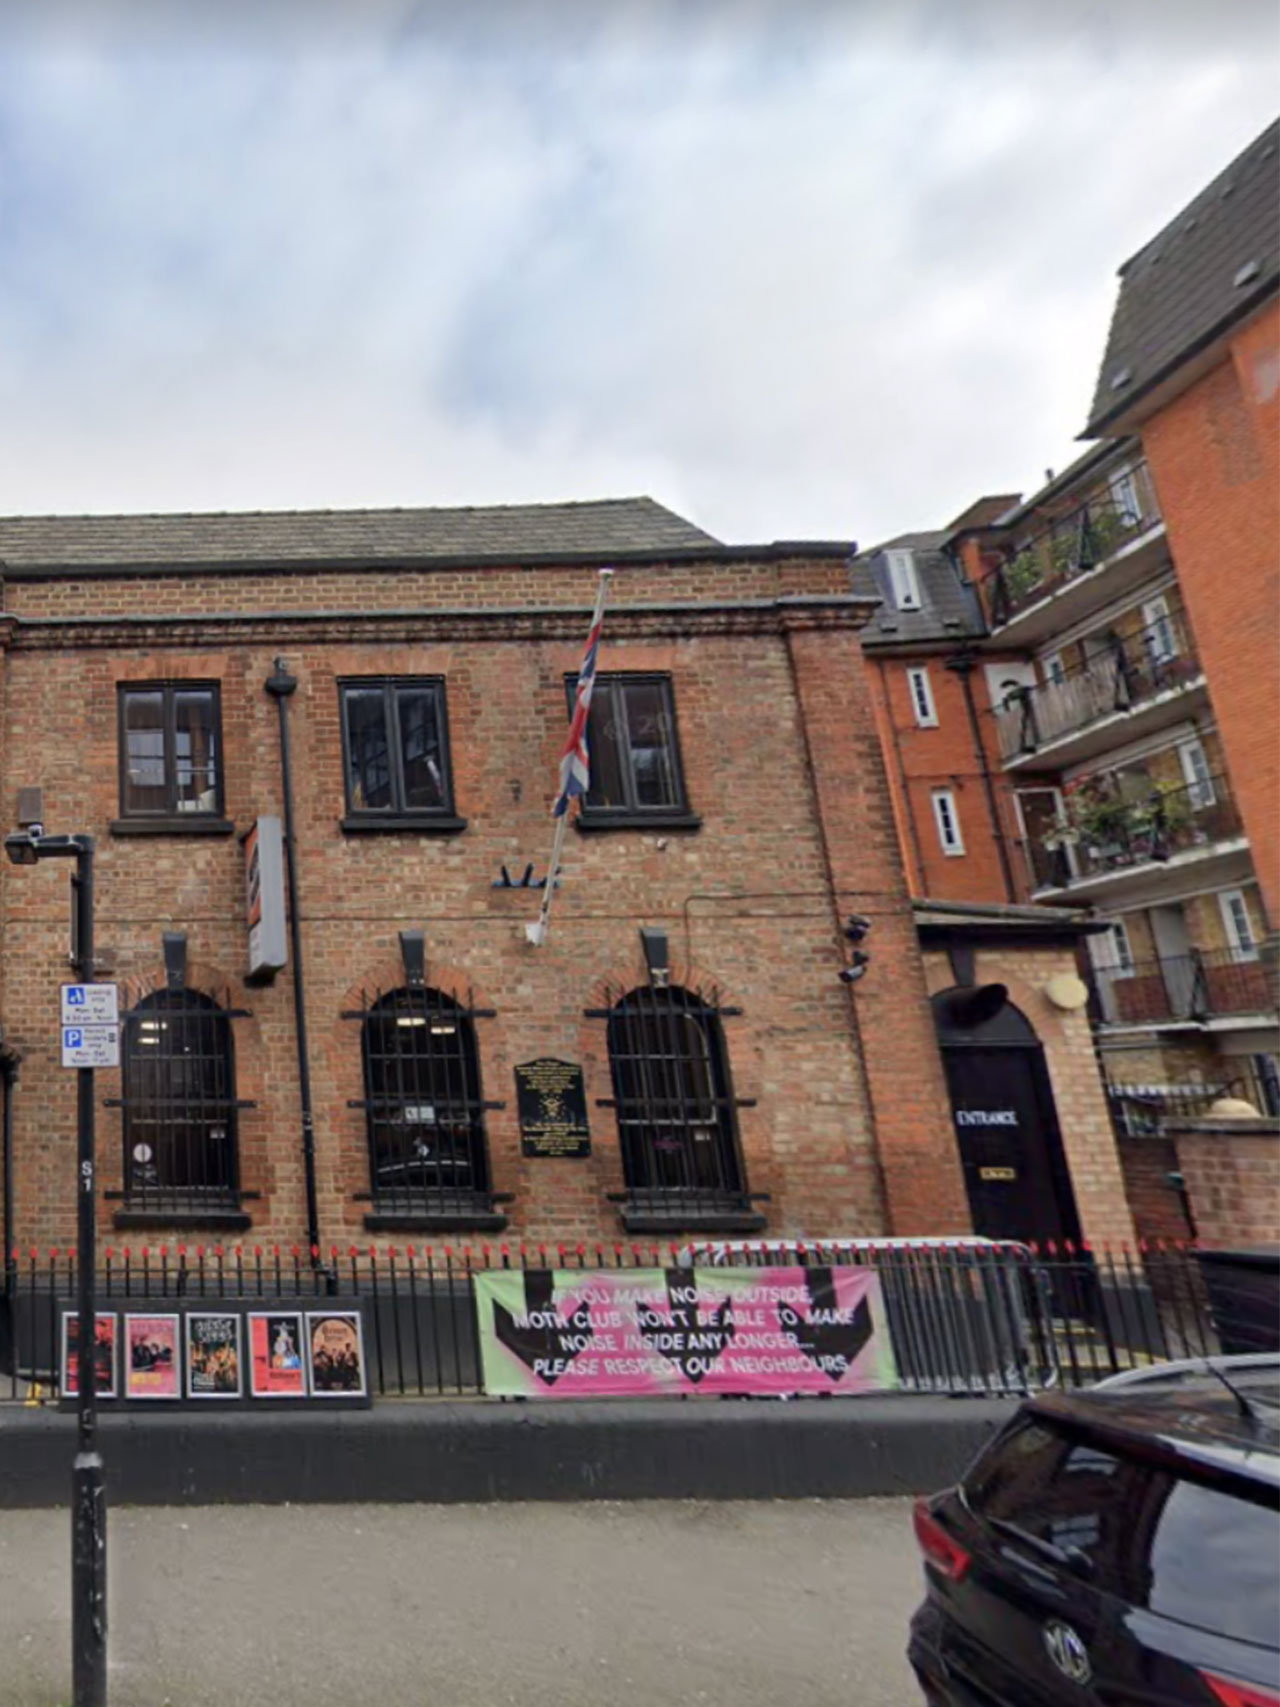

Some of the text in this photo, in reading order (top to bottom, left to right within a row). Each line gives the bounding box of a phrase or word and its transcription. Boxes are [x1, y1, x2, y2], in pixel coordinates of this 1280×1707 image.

[956, 1110, 1018, 1125] ENTRANCE
[82, 1161, 92, 1176] S
[573, 1287, 610, 1305] YOU
[614, 1288, 667, 1305] MAKE
[670, 1285, 725, 1304] NOISE
[512, 1307, 855, 1329] MOTH CLUB WON'T BE ABLE TO MAKE
[558, 1333, 617, 1352] NOISE
[624, 1332, 684, 1351] INSIDE
[686, 1333, 722, 1350] ANY
[533, 1354, 849, 1377] PLEASE RESPECT OUR NEIGHBOURS
